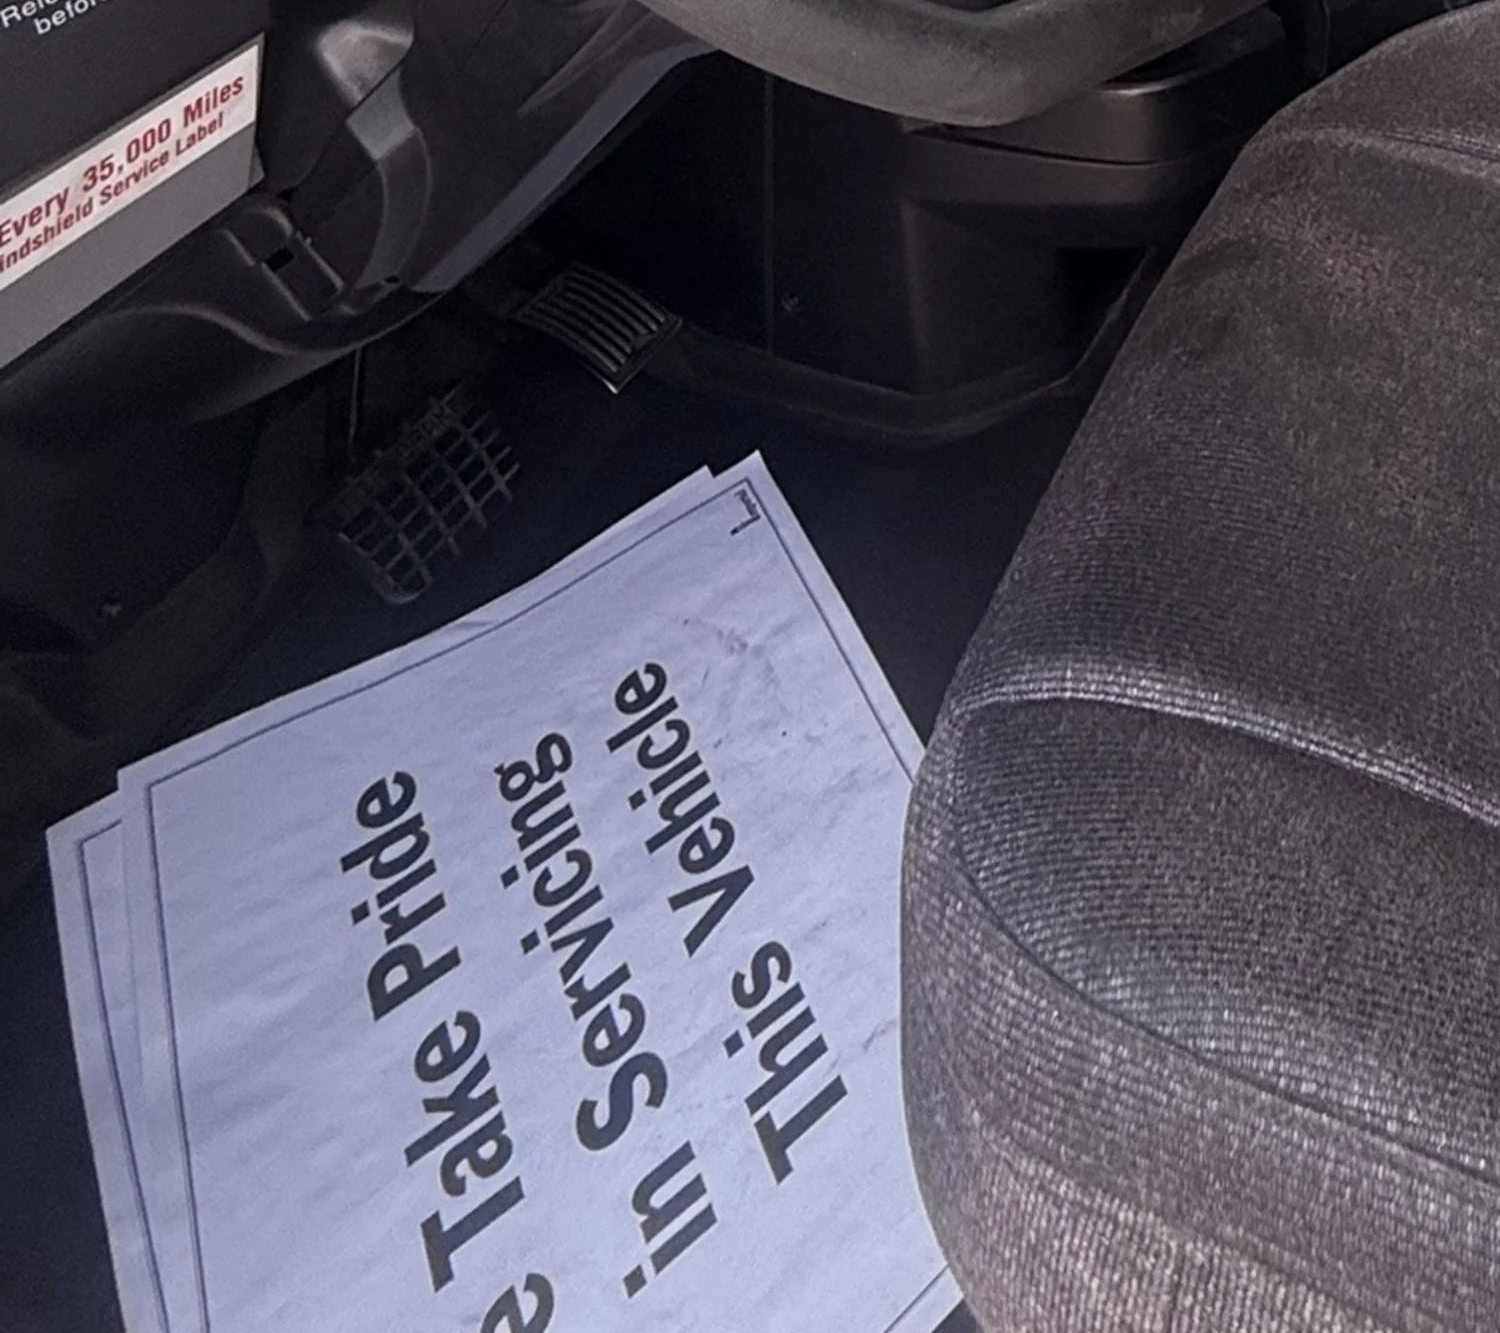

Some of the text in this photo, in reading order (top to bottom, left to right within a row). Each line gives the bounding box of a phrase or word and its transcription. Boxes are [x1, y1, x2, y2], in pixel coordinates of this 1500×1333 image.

[0, 76, 244, 248] Every 35,000 Miles
[0, 112, 224, 273] indshield Service Label
[340, 769, 462, 1022] Pride
[493, 731, 719, 1299] in Servicing
[603, 659, 848, 1185] This Vehicle
[404, 1010, 524, 1293] Take
